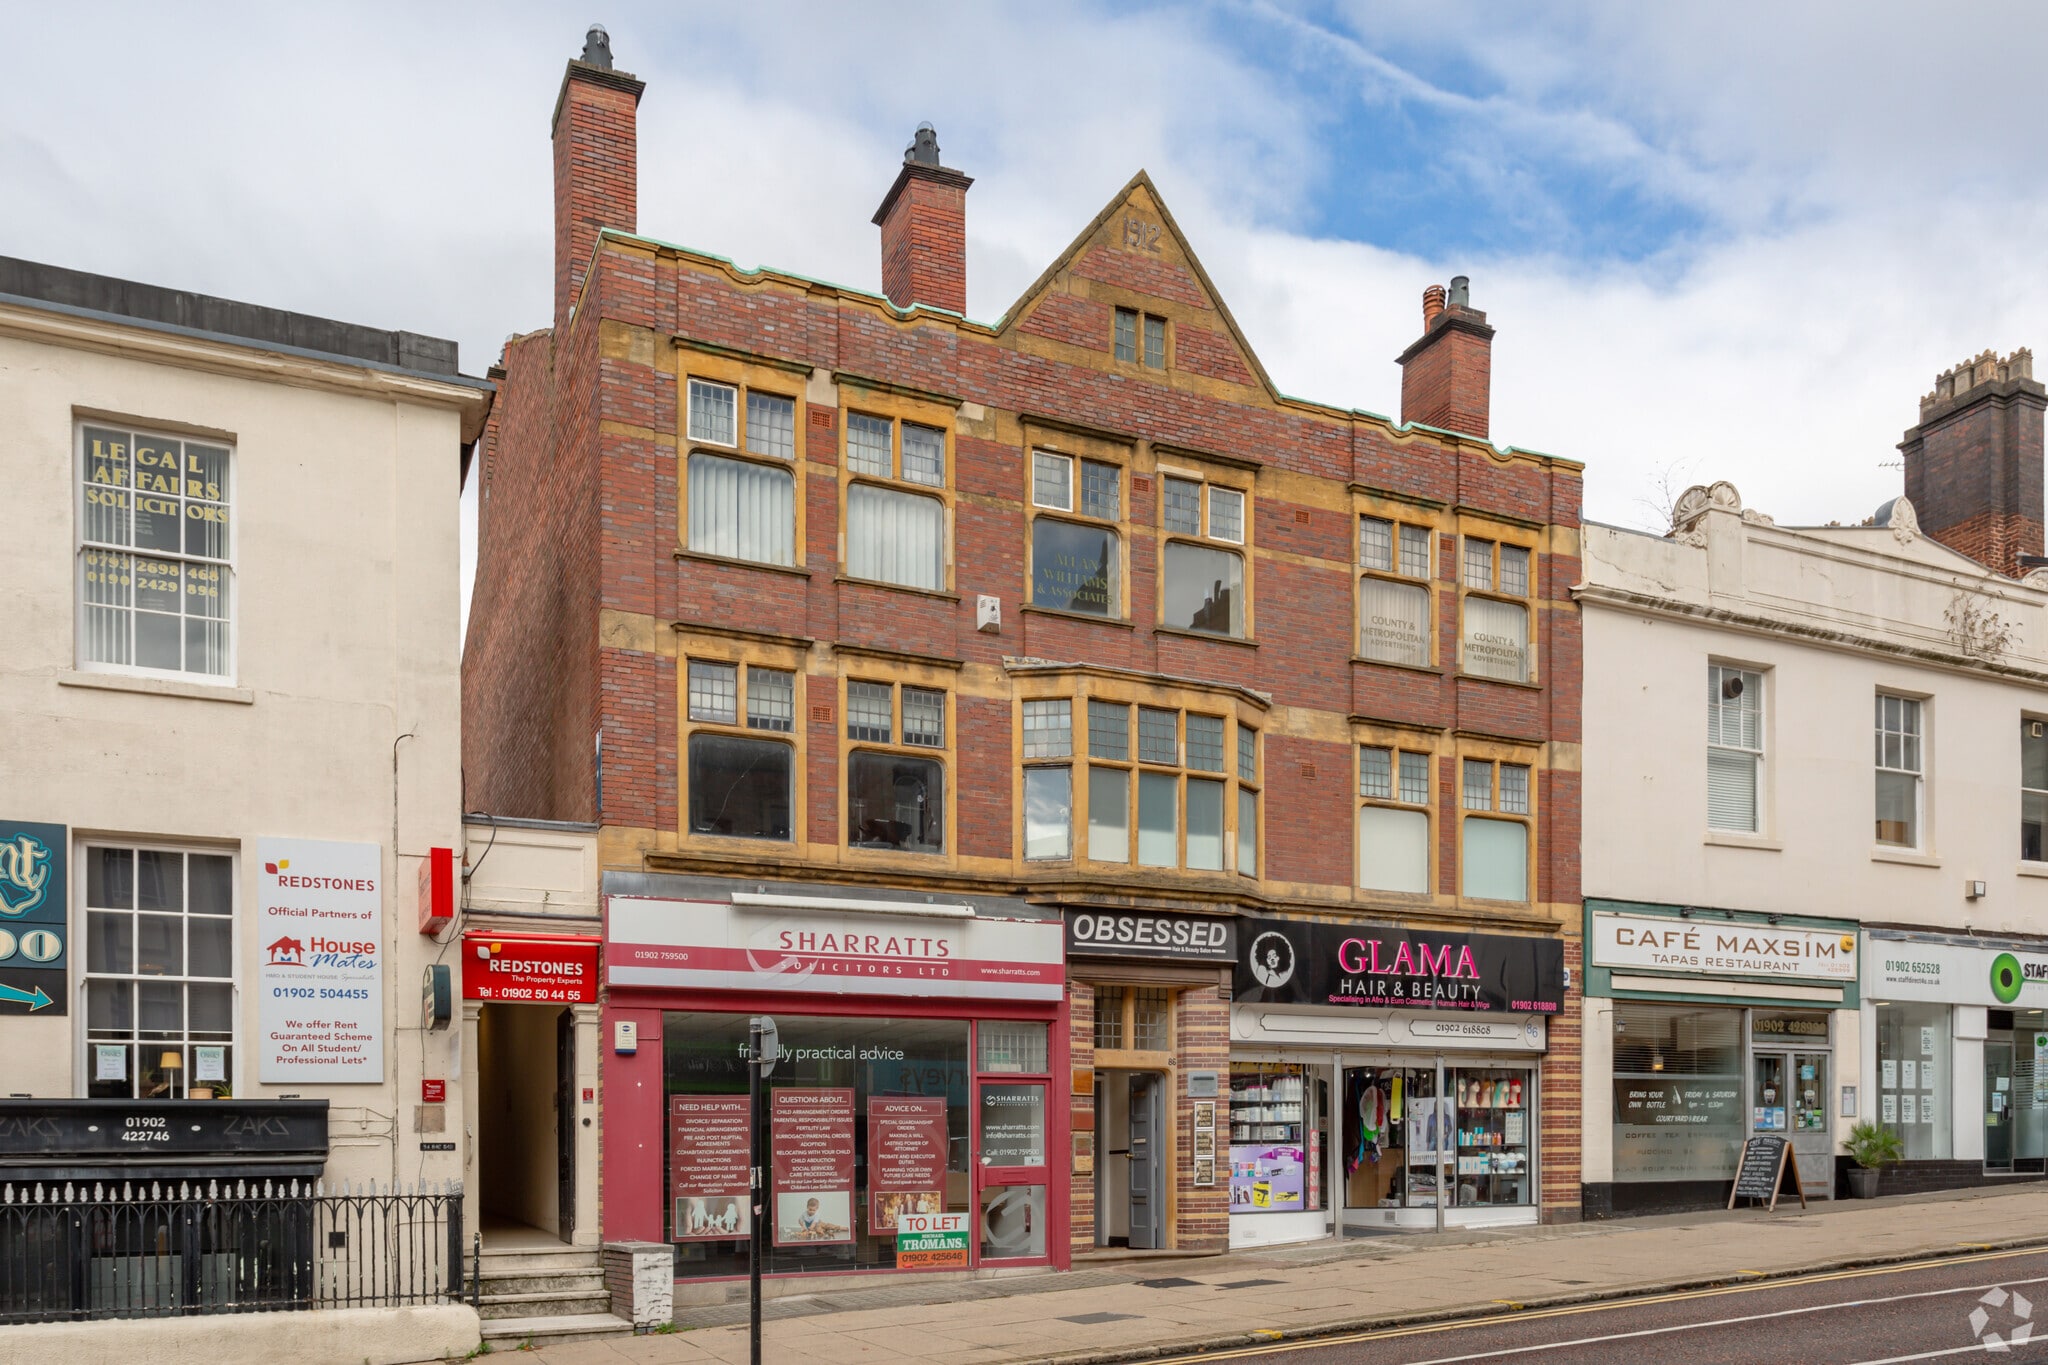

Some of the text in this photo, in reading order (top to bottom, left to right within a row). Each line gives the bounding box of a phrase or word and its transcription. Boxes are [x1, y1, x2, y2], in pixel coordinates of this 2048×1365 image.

[1122, 216, 1161, 254] 1912
[92, 439, 204, 474] LEGAL
[92, 465, 221, 503] AFFAIRS
[86, 488, 229, 524] SOLICITORS
[1043, 567, 1108, 590] WILLIAMS
[1049, 585, 1114, 605] ASSOCIATES
[1371, 616, 1416, 632] COUNTY &
[1360, 627, 1425, 645] METROPOLITAN
[1473, 632, 1515, 647] COUNTY &
[1370, 640, 1417, 653] ADVERTISING
[1464, 643, 1525, 660] METROPOLITAN
[1472, 654, 1516, 667] ADVERTISING
[279, 875, 375, 892] REDSTONES
[268, 906, 373, 920] Official Partners of
[1073, 914, 1228, 947] OBSESSED
[310, 936, 376, 954] House
[779, 930, 950, 958] SHARRATTS
[1615, 926, 1701, 951] CAFÉ
[310, 952, 379, 969] Mates
[635, 950, 689, 962] 01902 759500
[1337, 937, 1480, 980] GLAMA
[1651, 953, 1700, 967] TAPAS
[1705, 957, 1800, 972] RESTAURANT
[489, 959, 584, 977] REDSTONES
[780, 961, 950, 977] SOLICITORS LTD
[980, 966, 1041, 977] www.sharratts.com
[1885, 960, 1941, 975] 01902 652528
[512, 975, 583, 986] The Property Experts
[273, 987, 369, 999] 01902 504455
[478, 987, 492, 998] Tel
[502, 988, 532, 999] 01902
[535, 989, 549, 1000] 50
[551, 990, 565, 1000] 44
[567, 991, 581, 1001] 55
[1340, 979, 1481, 1001] HAIR & BEAUTY
[1328, 994, 1364, 1005] Specialising
[1370, 995, 1384, 1004] Afro
[1390, 997, 1404, 1005] Euro
[1436, 999, 1457, 1008] Human
[1457, 1000, 1470, 1008] Hair
[1475, 1001, 1490, 1010] Wigs
[1511, 1000, 1531, 1011] 01902
[286, 1020, 358, 1029] We offer Rent
[1435, 1023, 1490, 1035] 01902 618808
[1525, 1023, 1538, 1038] 86
[1753, 1019, 1785, 1033] 01902
[270, 1032, 373, 1042] Guaranteed Scheme
[282, 1044, 362, 1053] On All Student/
[737, 1042, 905, 1065] fridly practical advice
[276, 1056, 339, 1065] Professional
[779, 1096, 819, 1104] QUESTIONS
[1628, 1091, 1647, 1099] BRING
[679, 1103, 699, 1112] NEED
[700, 1103, 720, 1111] HELP
[125, 1116, 167, 1129] 01902
[985, 1123, 1040, 1131] www.sharratts.com
[121, 1130, 171, 1142] 422746
[999, 1148, 1018, 1156] 01902
[906, 1216, 962, 1231] TO LET
[902, 1238, 963, 1251] TROMANS
[902, 1253, 928, 1262] 01902
